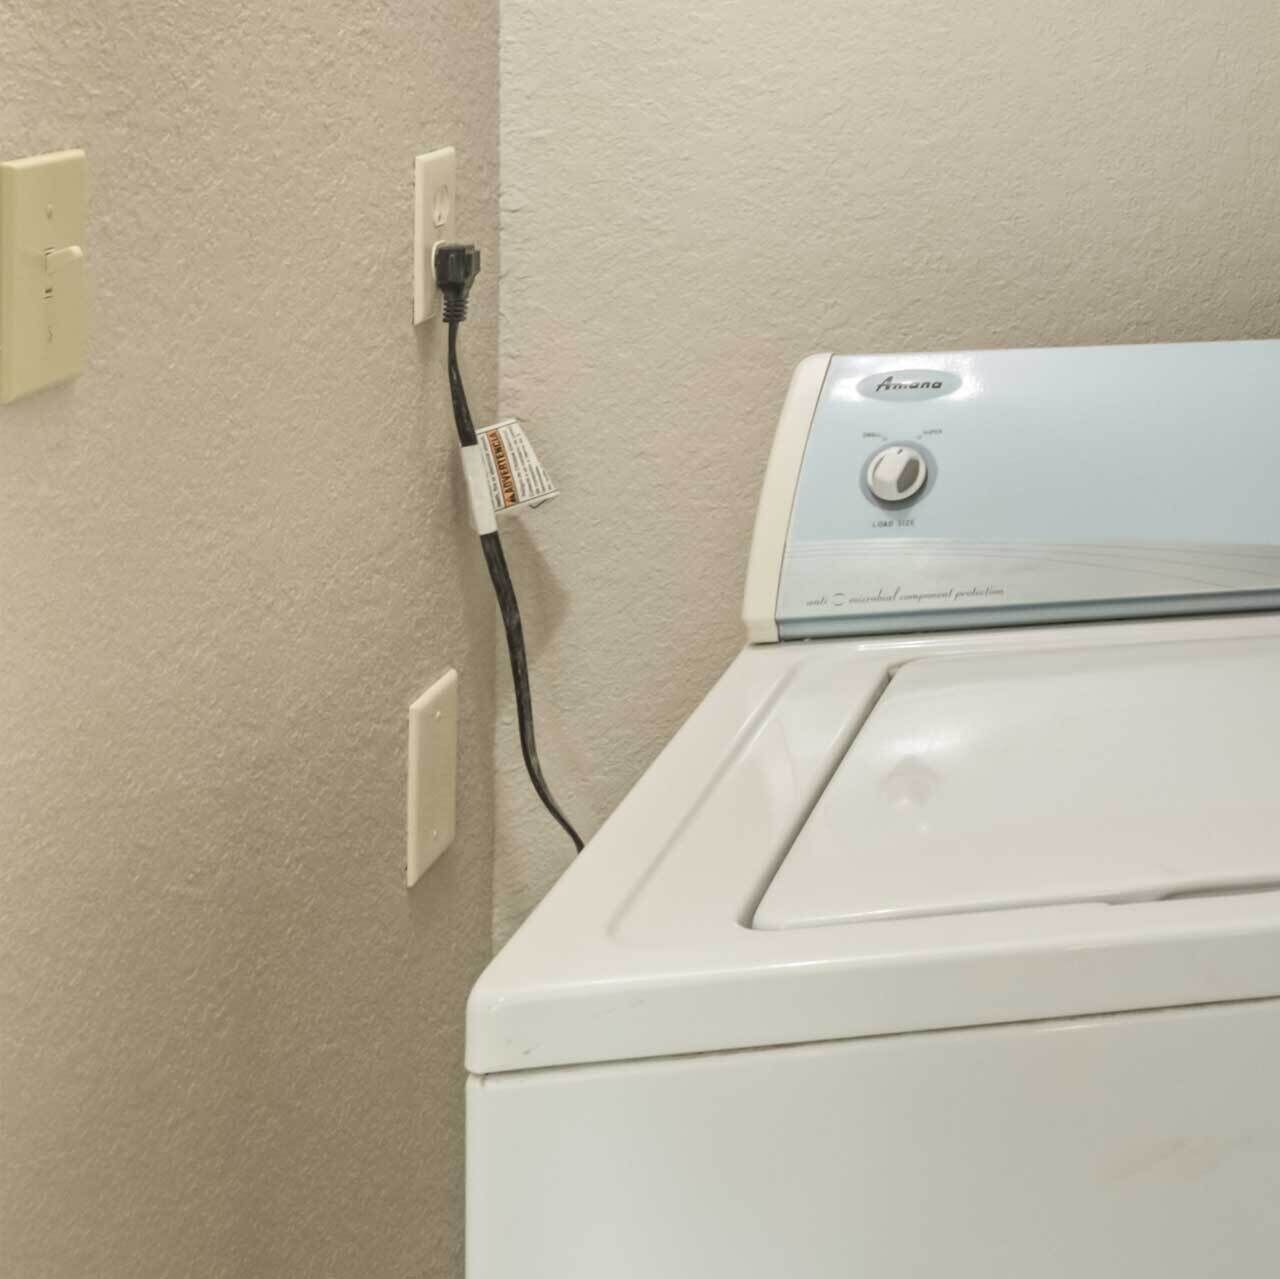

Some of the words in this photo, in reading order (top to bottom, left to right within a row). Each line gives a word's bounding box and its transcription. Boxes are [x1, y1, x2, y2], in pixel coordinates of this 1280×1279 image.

[875, 375, 943, 393] Amana
[872, 520, 894, 529] LOAD
[897, 518, 915, 527] SIZE
